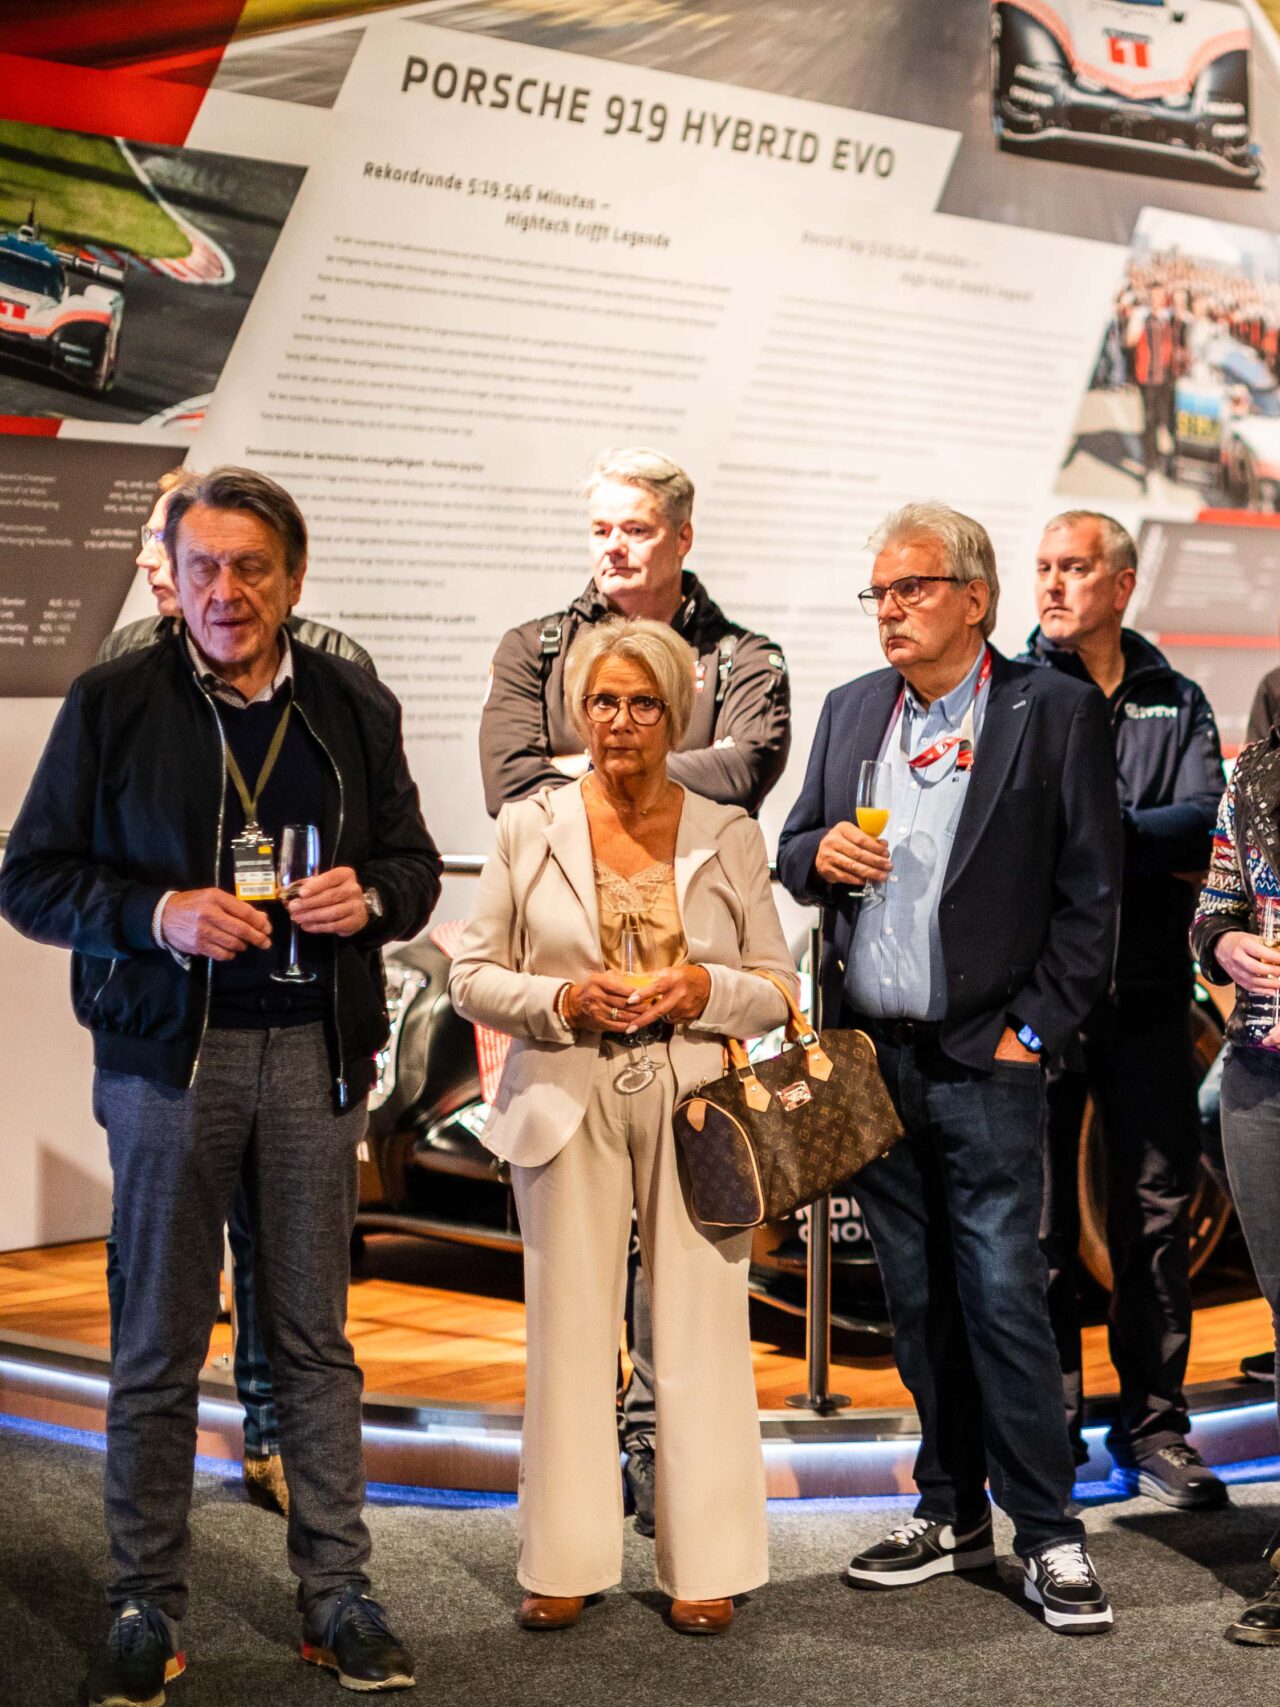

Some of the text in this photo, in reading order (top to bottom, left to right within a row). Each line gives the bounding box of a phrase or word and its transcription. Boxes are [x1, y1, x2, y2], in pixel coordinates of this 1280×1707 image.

[401, 55, 896, 178] PORSCHE 919 HYBRID EVO
[363, 161, 463, 190] Rekordrunde
[536, 189, 596, 211] Minuten
[504, 210, 570, 235] Hightech
[613, 226, 671, 249] Legende
